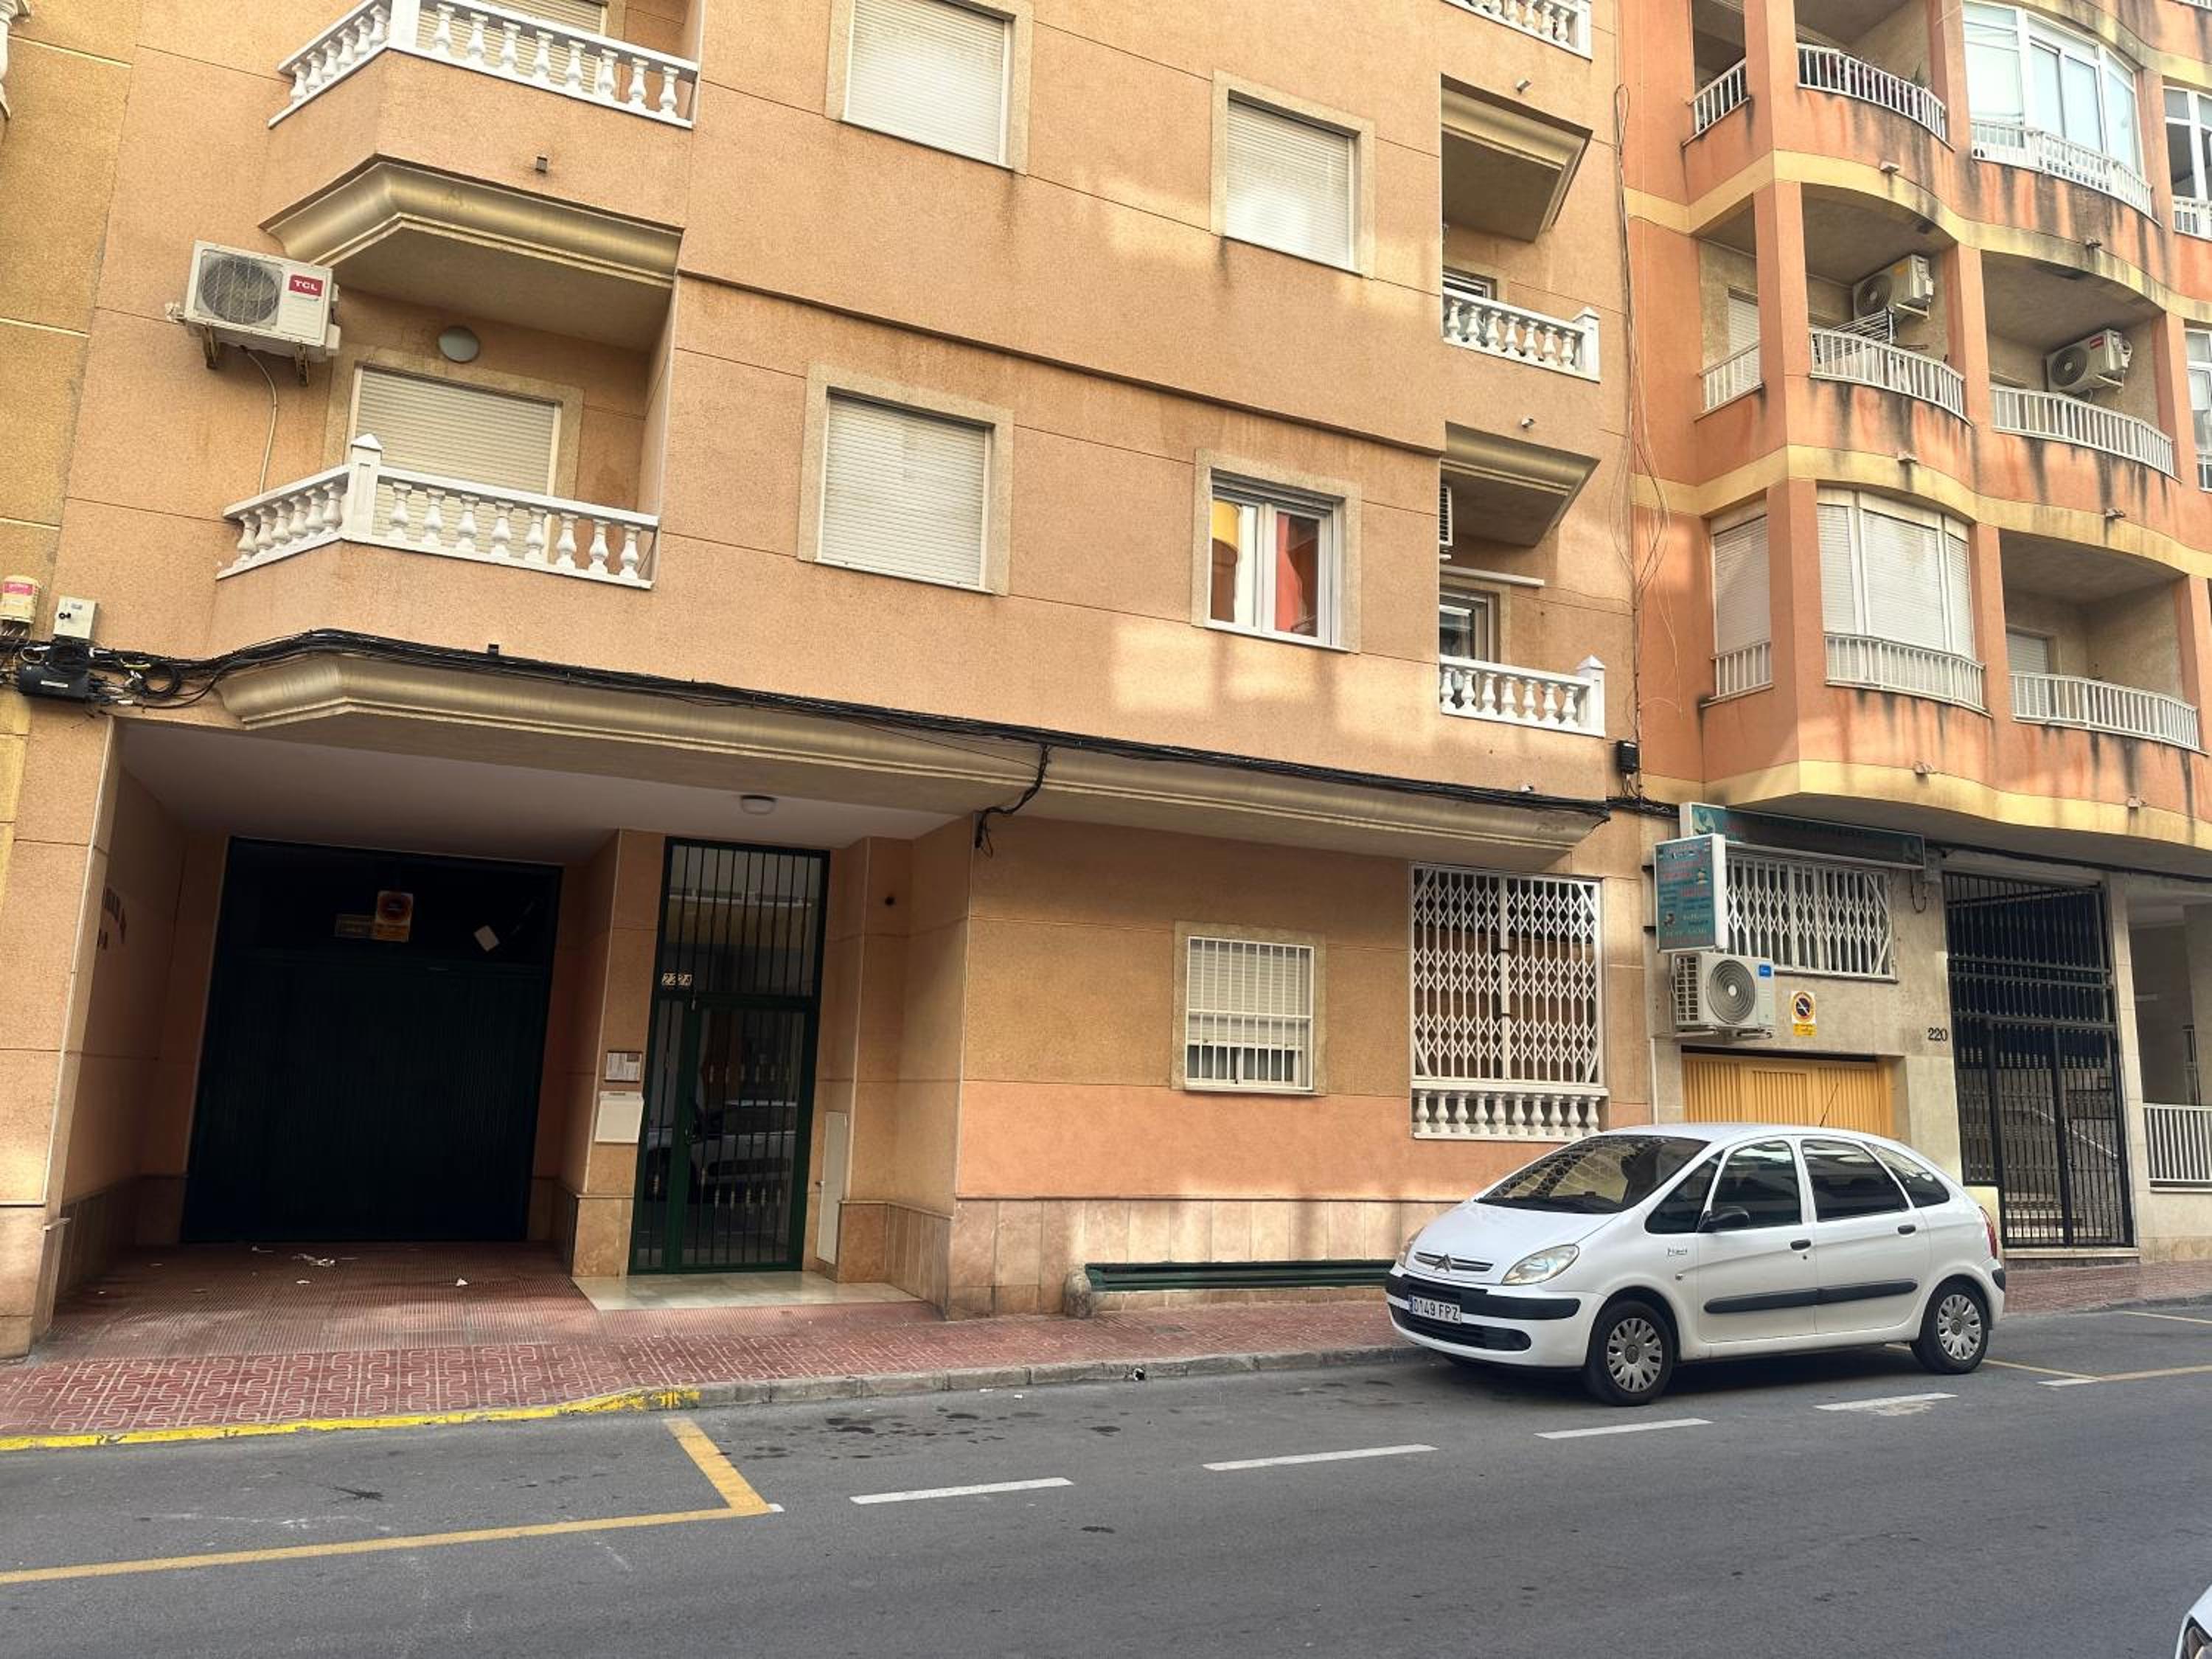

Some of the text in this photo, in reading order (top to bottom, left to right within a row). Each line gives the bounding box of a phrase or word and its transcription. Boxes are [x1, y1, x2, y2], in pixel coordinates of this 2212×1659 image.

[294, 279, 318, 291] TCL
[1927, 1027, 1948, 1041] 220
[1439, 1303, 1459, 1321] FPZ
